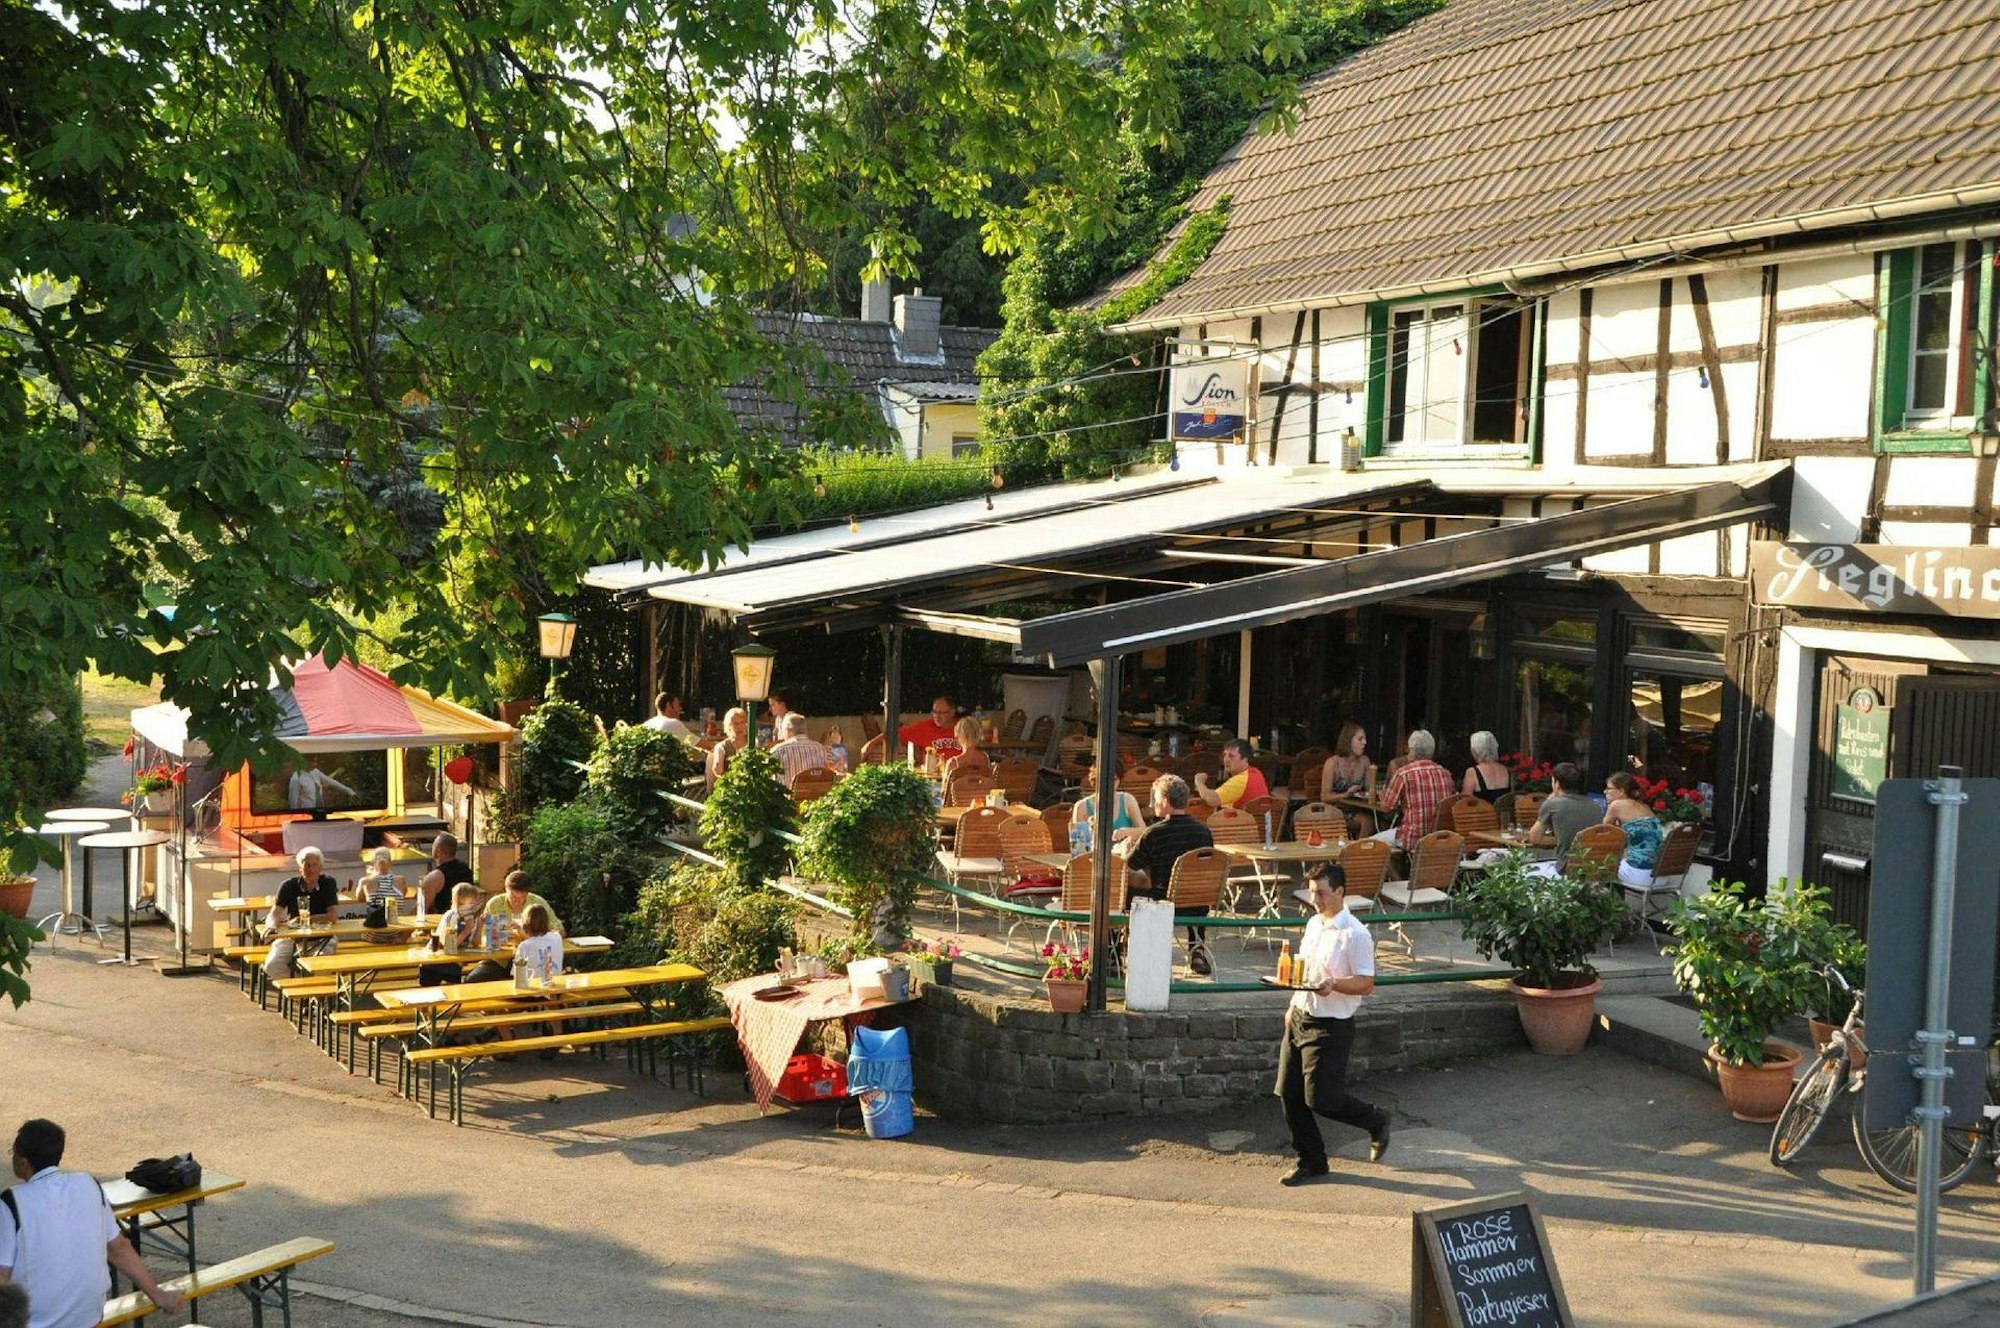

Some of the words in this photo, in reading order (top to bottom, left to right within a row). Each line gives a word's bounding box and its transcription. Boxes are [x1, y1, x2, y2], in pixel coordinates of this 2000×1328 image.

[1182, 373, 1235, 405] Sion
[1440, 1231, 1518, 1265] Hammer
[1457, 1256, 1536, 1286] Sommer
[1457, 1288, 1549, 1327] Portugieser
